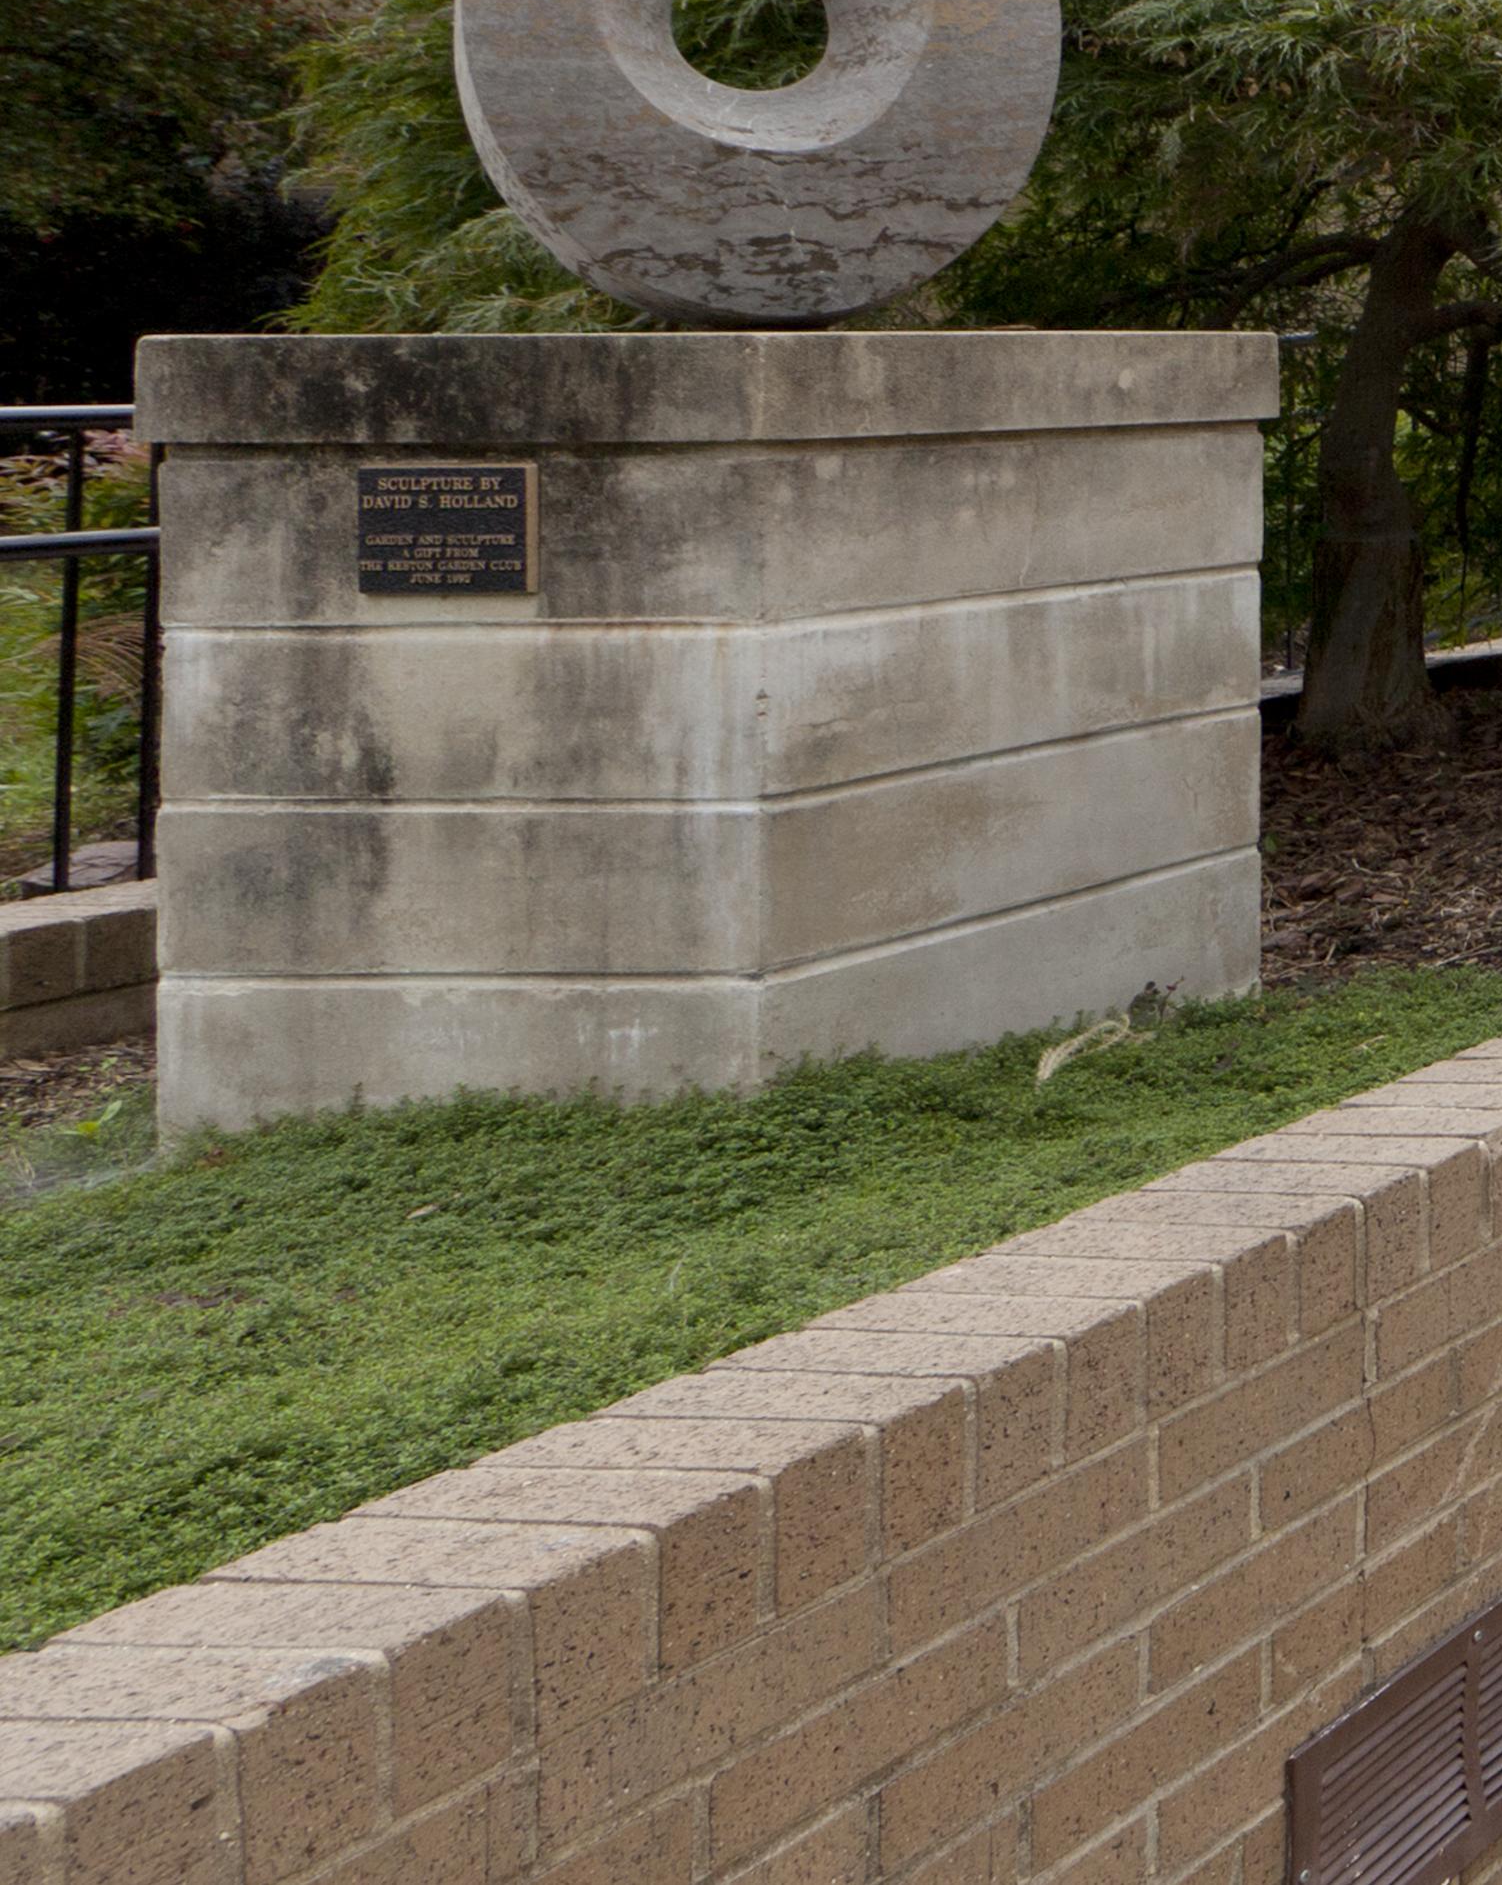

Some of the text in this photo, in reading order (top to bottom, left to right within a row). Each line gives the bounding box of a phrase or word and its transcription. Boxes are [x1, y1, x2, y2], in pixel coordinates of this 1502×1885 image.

[378, 477, 501, 490] SCULPTURE BY
[363, 495, 411, 509] DAVID
[440, 495, 518, 508] HOLLAND
[365, 534, 515, 545] GARDEN AND SCULPTURE
[403, 548, 479, 558] A GIFT FROM
[360, 561, 521, 571] THE RESTON GARDEN CLUB
[410, 574, 442, 583] JUNE
